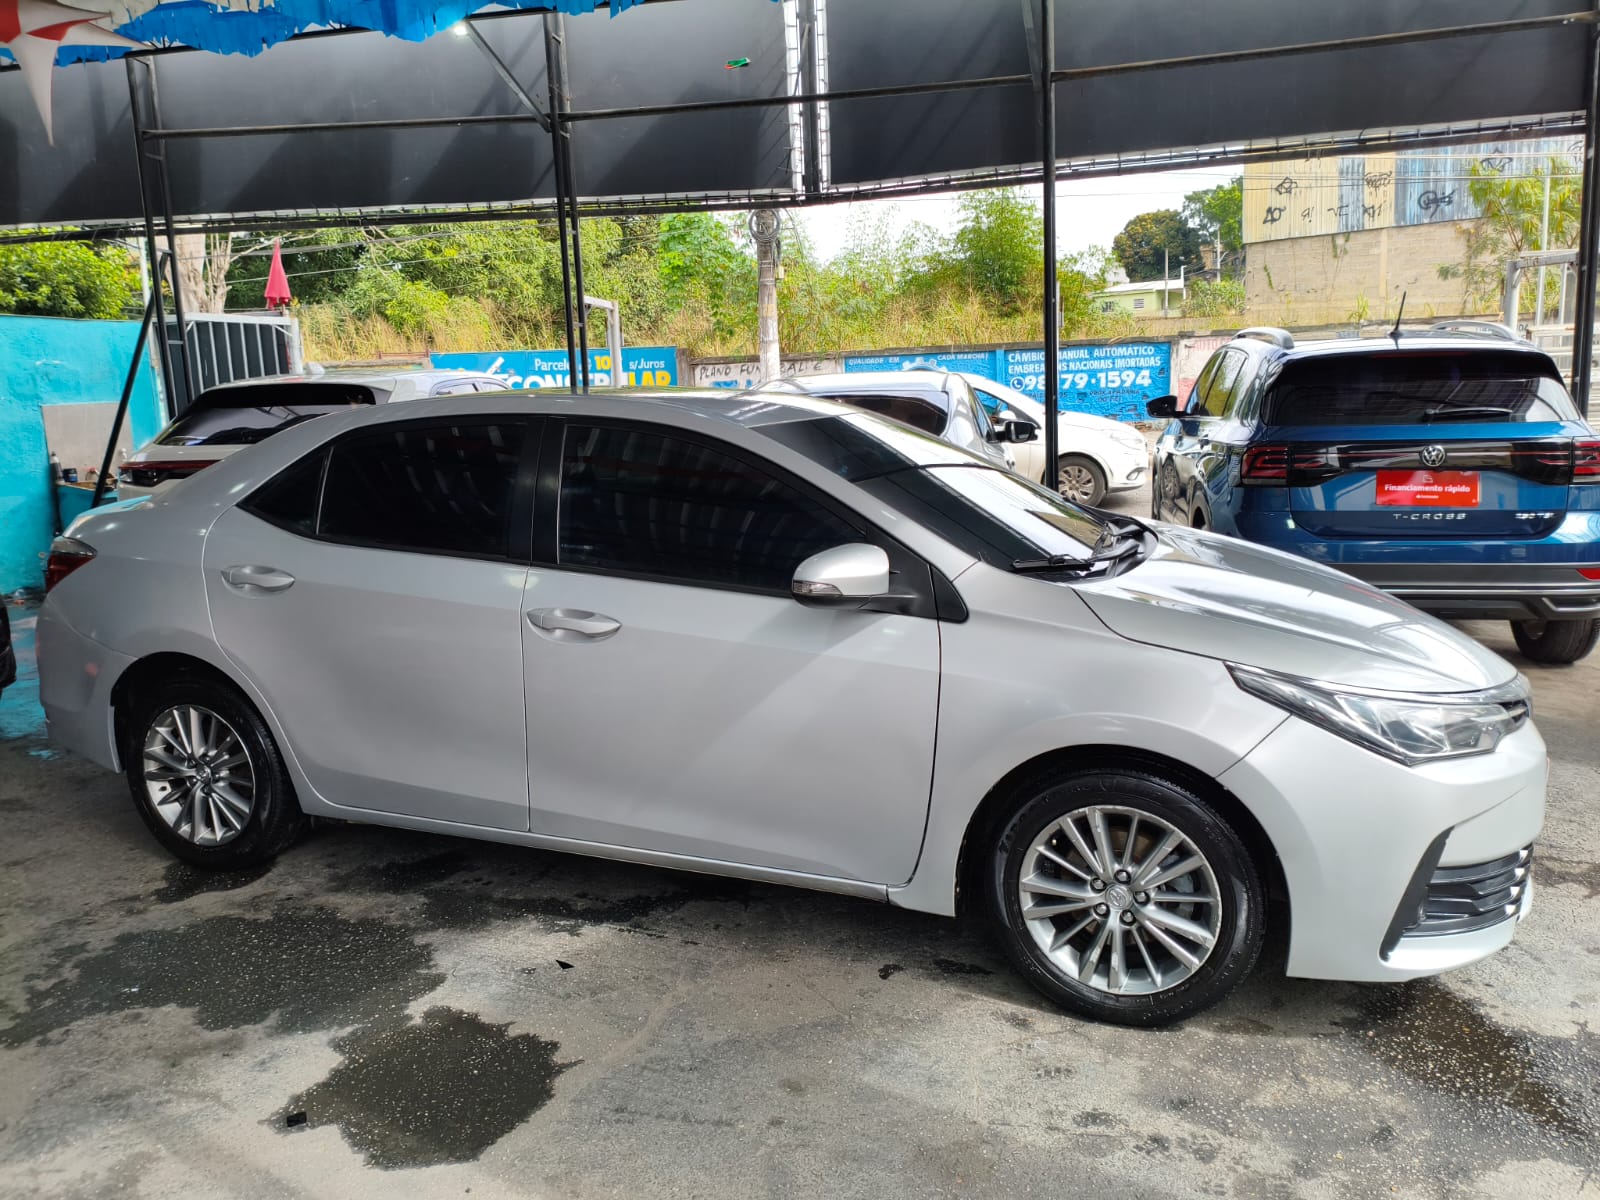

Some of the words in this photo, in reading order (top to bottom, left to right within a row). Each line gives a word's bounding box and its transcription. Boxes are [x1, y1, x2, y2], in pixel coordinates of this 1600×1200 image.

[628, 358, 665, 370] s/Juros
[1069, 359, 1113, 372] NACIONAIS
[1384, 483, 1443, 492] Financiamento
[1444, 484, 1471, 494] rápido
[1393, 512, 1467, 520] T-CROSS
